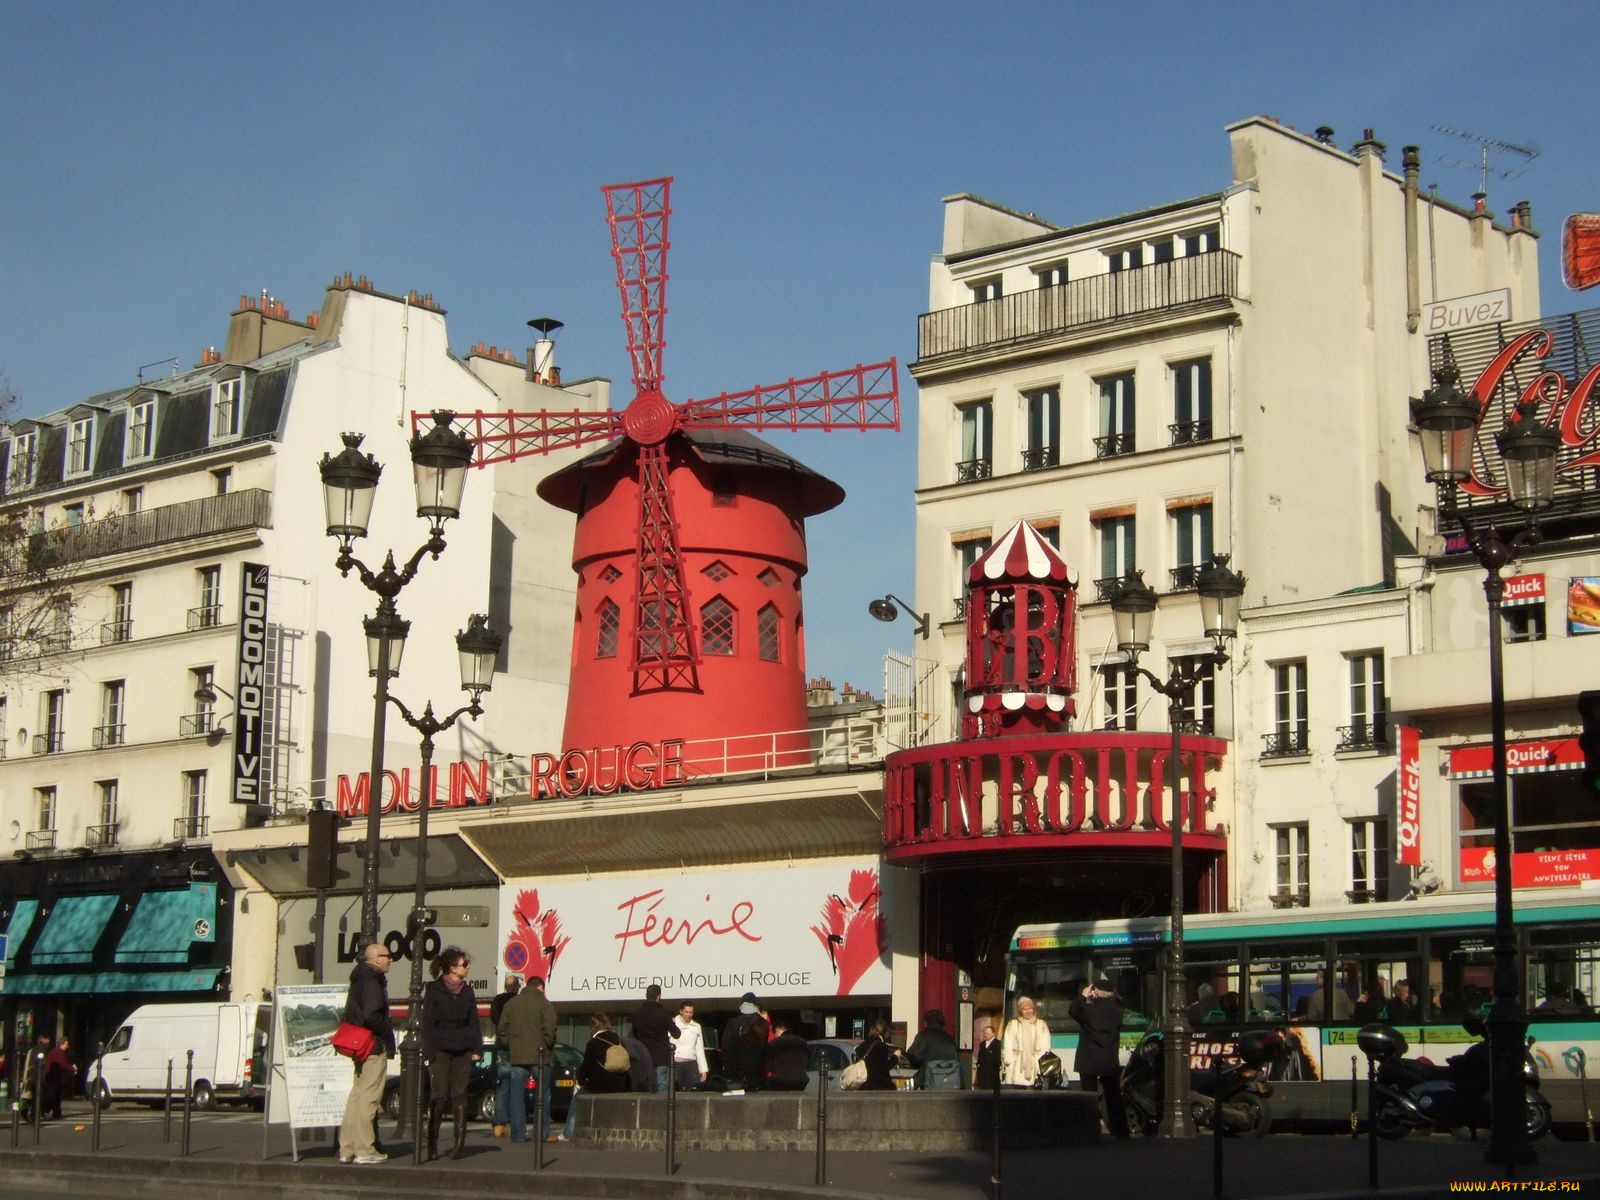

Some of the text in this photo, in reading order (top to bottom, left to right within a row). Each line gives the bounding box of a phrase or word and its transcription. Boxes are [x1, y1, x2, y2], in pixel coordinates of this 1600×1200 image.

[1429, 299, 1503, 331] Buvez
[1502, 579, 1542, 599] Quick
[236, 572, 265, 801] LOCOMOTIVE
[1507, 748, 1553, 767] Quick
[337, 739, 684, 817] MOULIN ROUGE
[1401, 758, 1421, 848] Quick
[1538, 854, 1561, 863] VIENS
[615, 889, 763, 963] Féerie
[570, 970, 812, 992] LA REVUE DU MOULIN ROUGE
[1332, 1031, 1345, 1044] 74
